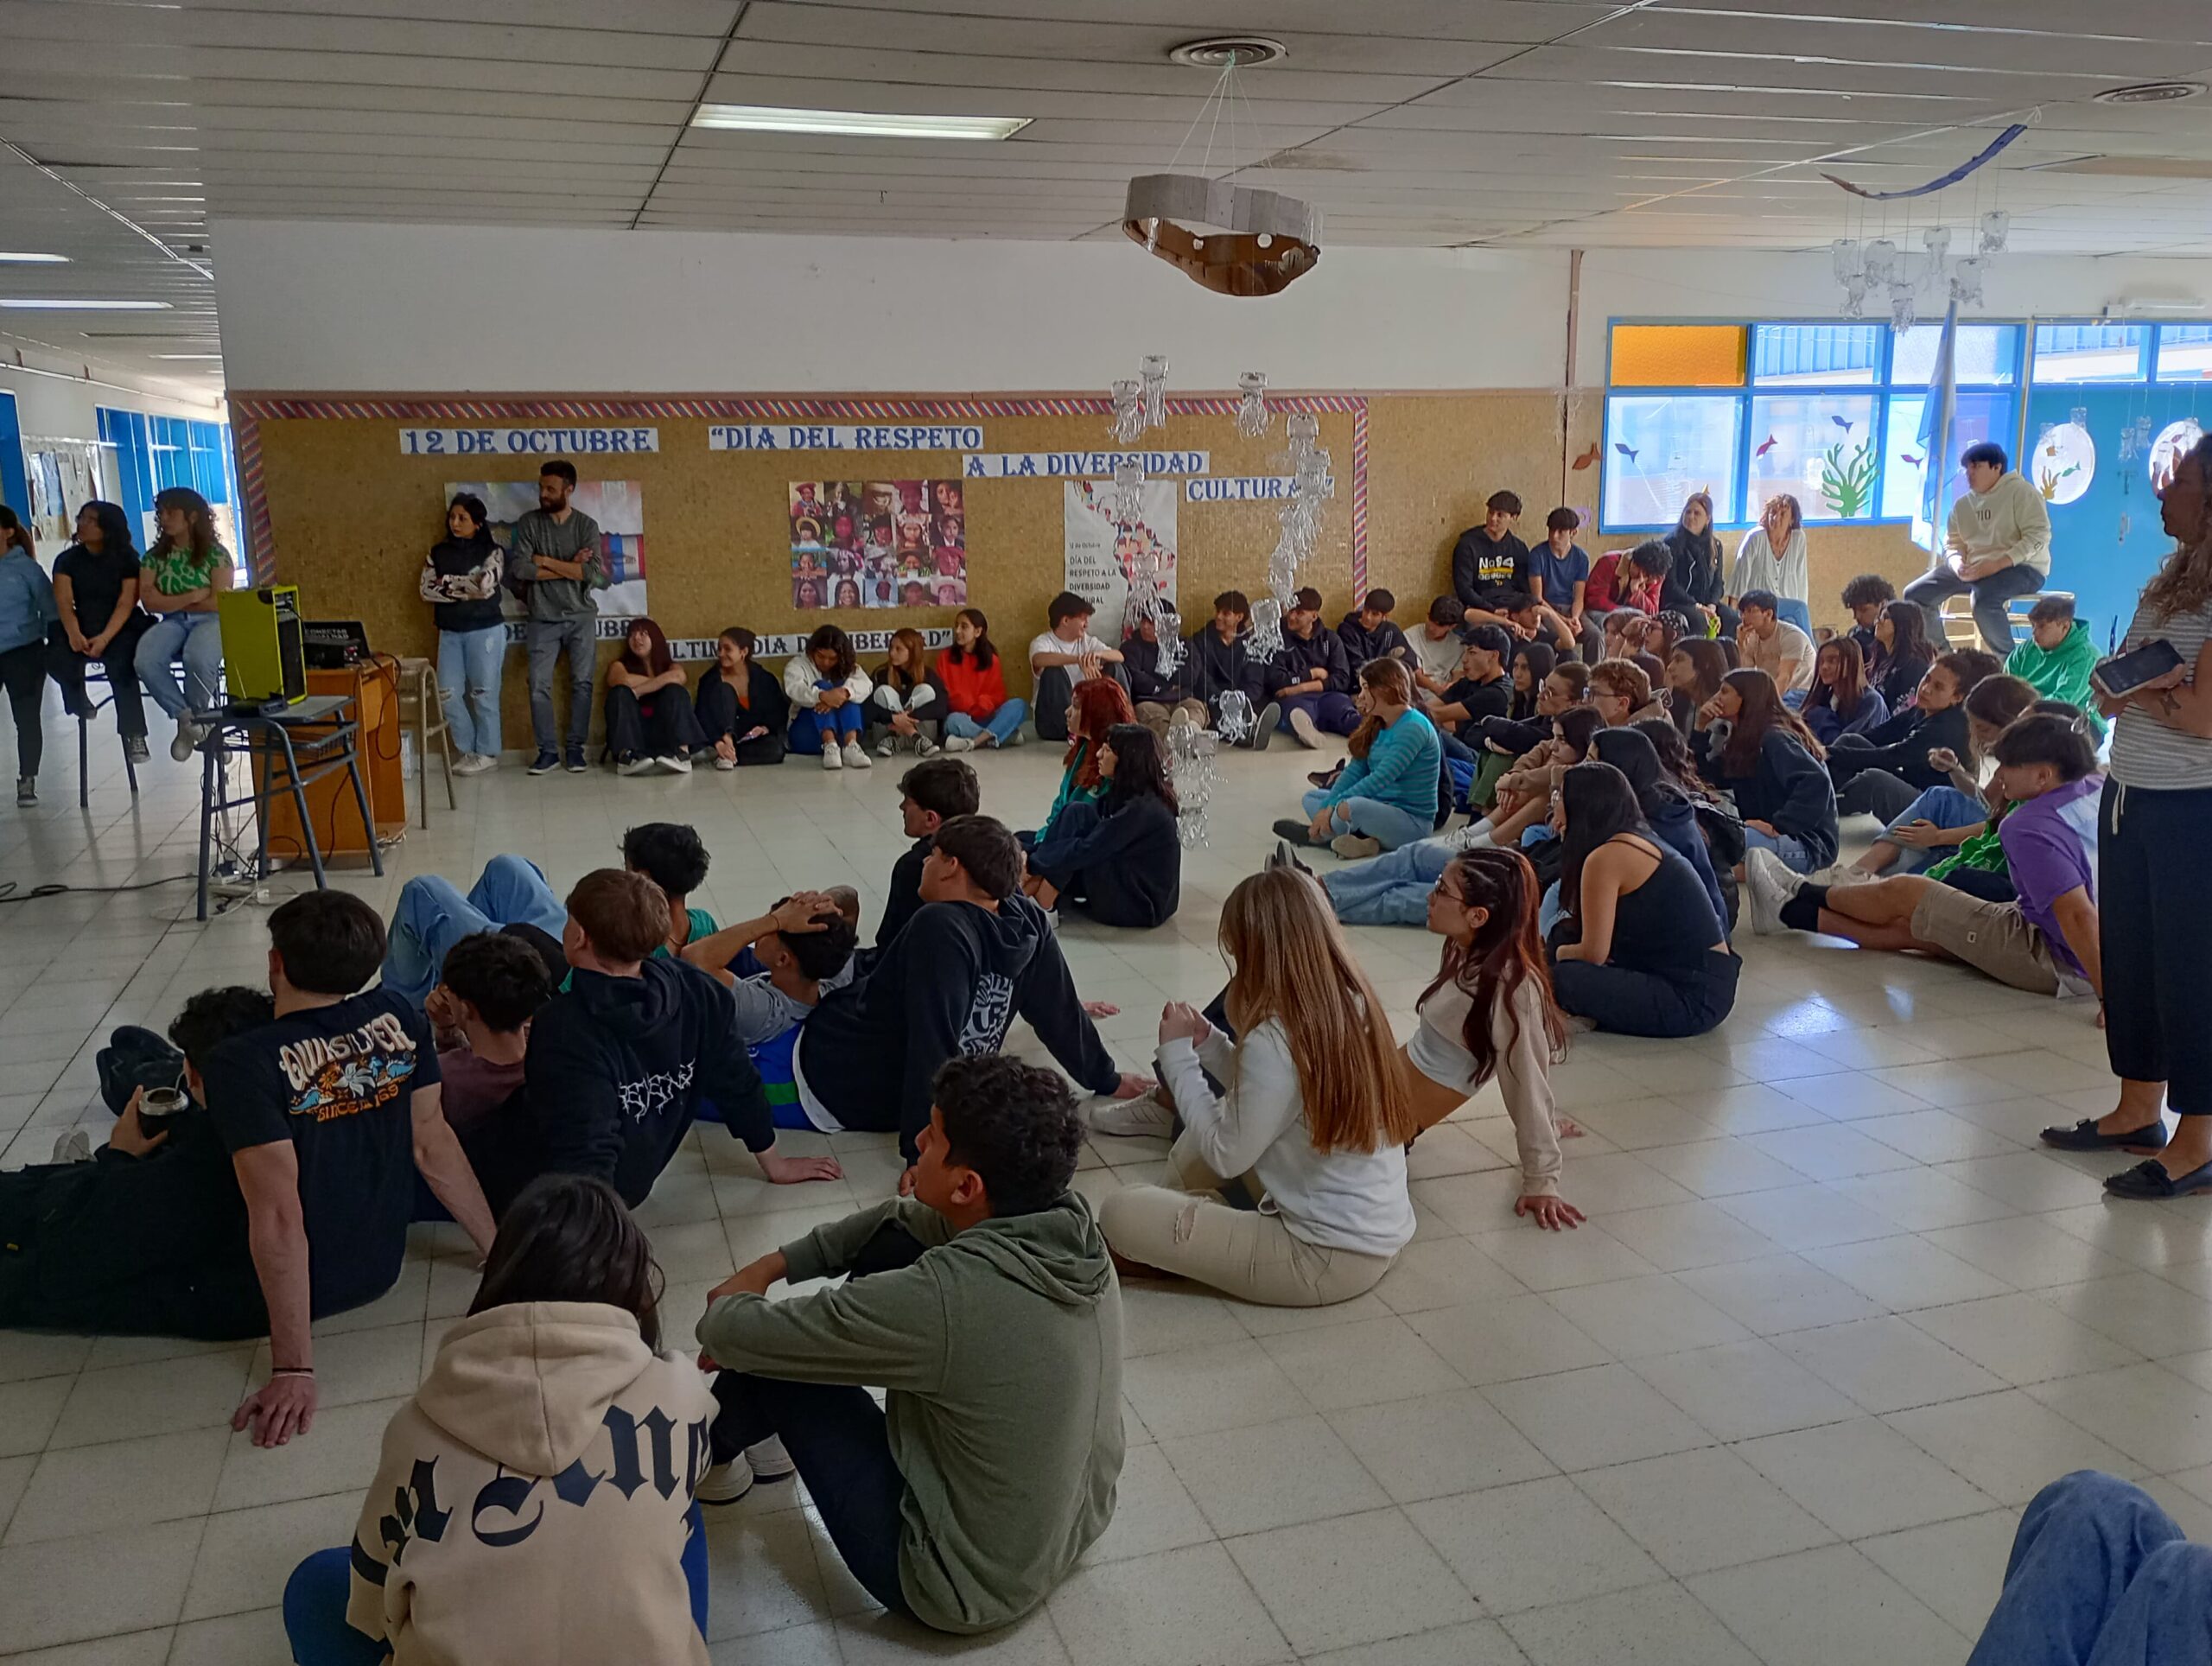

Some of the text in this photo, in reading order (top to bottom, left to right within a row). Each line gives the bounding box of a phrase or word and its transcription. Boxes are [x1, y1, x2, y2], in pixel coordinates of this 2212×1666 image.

[406, 429, 652, 454] 12 DE OCTUBRE
[789, 427, 844, 449] DEL
[855, 427, 981, 449] RESPETO
[967, 455, 986, 477] A
[1001, 455, 1037, 476] LA
[1188, 478, 1333, 500] CULTURA”
[1070, 555, 1096, 565] DÍA DEL
[1069, 568, 1116, 577] RESPETO A LA
[1069, 582, 1111, 591] DIVERSIDAD
[279, 1012, 417, 1091] QUIKSILVER
[317, 1100, 359, 1122] SINCE
